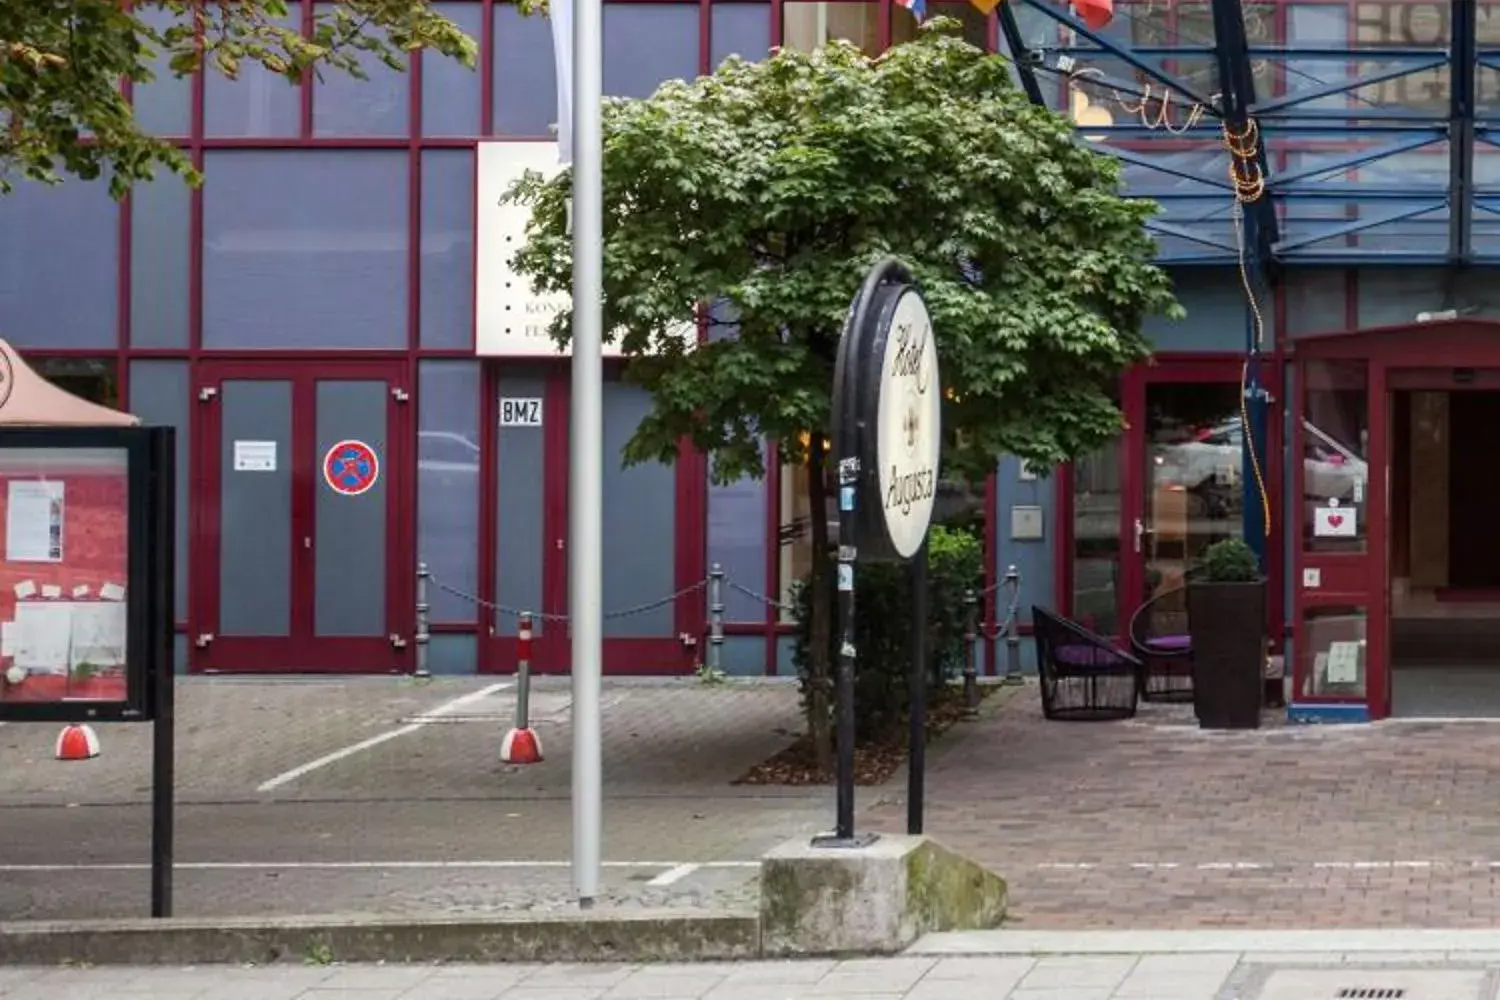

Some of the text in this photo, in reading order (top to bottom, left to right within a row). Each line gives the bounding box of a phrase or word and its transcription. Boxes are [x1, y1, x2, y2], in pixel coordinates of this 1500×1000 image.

[892, 323, 929, 395] Hotel
[503, 401, 539, 423] BMZ
[886, 465, 934, 516] Augusta
